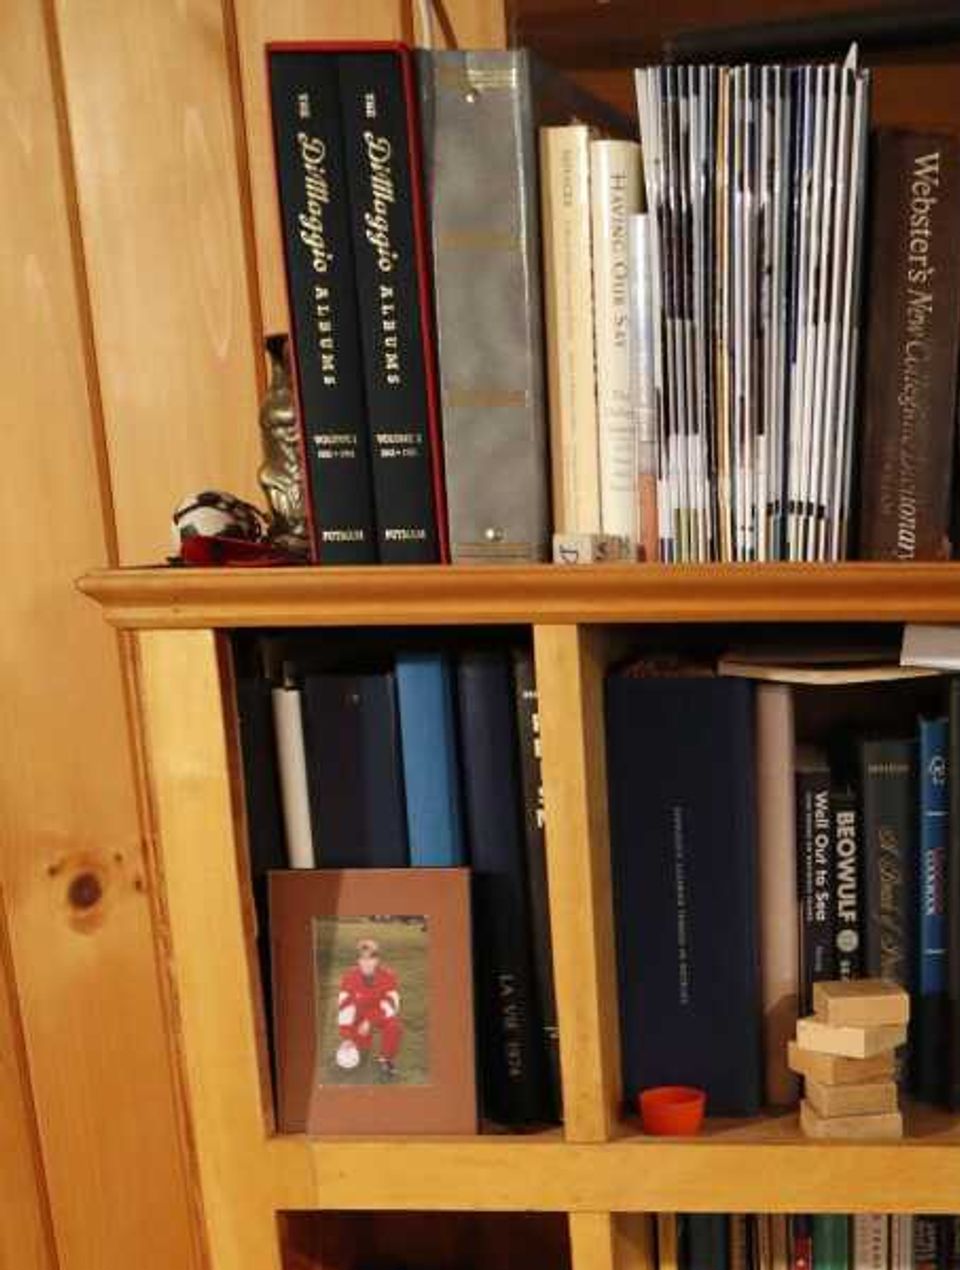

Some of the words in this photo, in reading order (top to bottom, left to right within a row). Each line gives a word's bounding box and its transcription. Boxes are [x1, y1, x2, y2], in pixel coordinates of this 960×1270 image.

[296, 131, 333, 273] DiMaggio
[361, 131, 399, 272] DiMaggio
[907, 152, 939, 282] Webster's
[612, 262, 627, 306] OUR
[906, 289, 933, 336] New
[314, 286, 336, 387] ALBUMS
[378, 285, 400, 386] ALBUMS
[815, 790, 829, 829] Well
[815, 834, 829, 864] Out
[816, 869, 828, 886] to
[835, 811, 857, 923] BEOWULF
[815, 892, 830, 922] Sea
